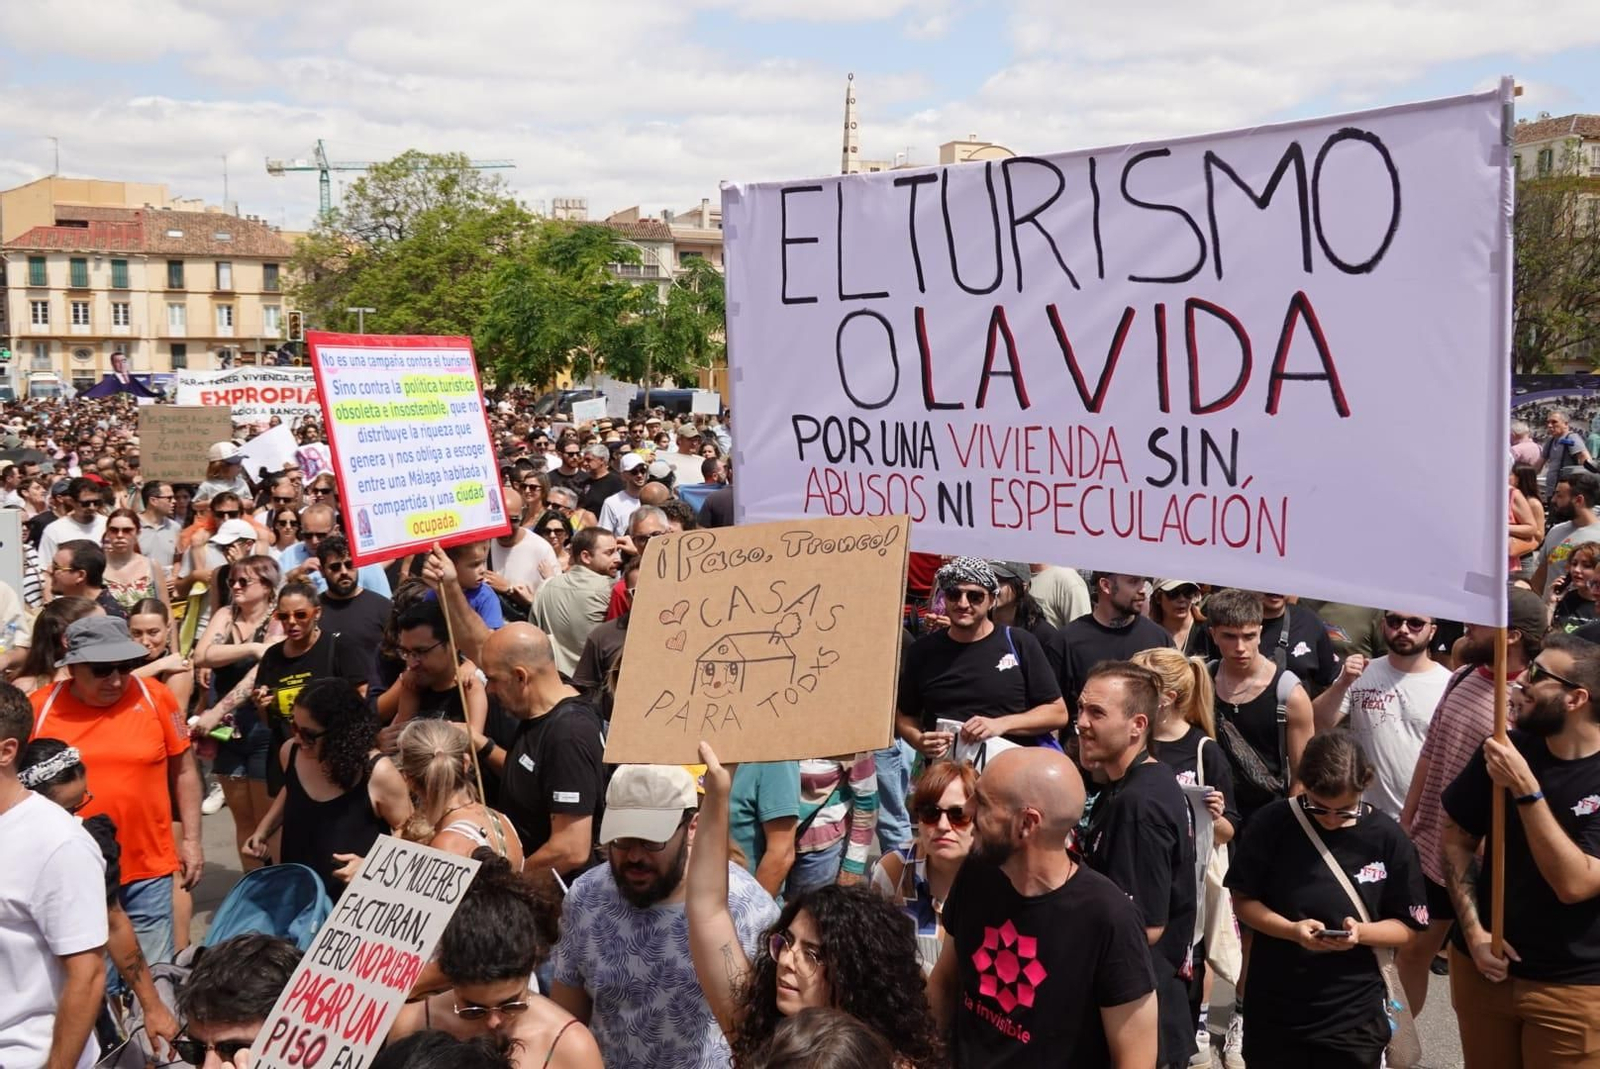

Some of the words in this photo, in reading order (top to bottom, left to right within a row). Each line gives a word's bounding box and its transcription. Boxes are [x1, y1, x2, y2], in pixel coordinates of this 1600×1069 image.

[780, 185, 889, 304] EL
[894, 127, 1401, 294] TURISMO
[321, 353, 335, 367] No
[337, 356, 348, 367] es
[349, 356, 366, 367] una
[367, 354, 405, 370] campaña
[406, 355, 432, 367] contra
[433, 354, 441, 367] el
[442, 355, 471, 368] turismo
[835, 308, 900, 410] O
[914, 304, 1031, 412] LA
[1045, 290, 1351, 418] VIDA
[242, 374, 290, 382] VIVIENDA
[332, 379, 357, 396] Sino
[359, 380, 390, 395] contra
[392, 380, 402, 394] la
[404, 378, 438, 396] política
[439, 377, 475, 393] turística
[335, 403, 381, 420] obsoleta
[382, 405, 389, 418] e
[390, 401, 449, 418] insostenible,
[450, 401, 467, 417] que
[468, 401, 479, 413] no
[357, 426, 408, 444] distribuye
[410, 425, 419, 440] la
[420, 424, 453, 441] riqueza
[454, 423, 472, 438] que
[791, 414, 874, 465] POR
[880, 420, 940, 472] UNA
[947, 423, 1128, 483] VIVIENDA
[1145, 426, 1239, 488] SIN
[350, 454, 386, 473] genera
[388, 454, 394, 469] y
[397, 451, 414, 465] nos
[415, 448, 444, 465] obliga
[445, 447, 452, 458] a
[453, 443, 486, 460] escoger
[358, 476, 386, 493] entre
[388, 475, 407, 488] una
[408, 468, 442, 487] Málaga
[443, 465, 481, 482] habitada
[482, 465, 489, 480] y
[372, 498, 428, 516] compartida
[430, 496, 436, 511] y
[437, 492, 455, 505] una
[456, 485, 485, 503] ciudad
[804, 466, 926, 523] ABUSOS
[937, 479, 974, 528] NI
[990, 476, 1288, 558] ESPECULACIÓN
[412, 513, 458, 535] ocupada.
[781, 524, 900, 558] Tronco!
[699, 580, 845, 632] CASAS
[644, 689, 742, 733] PARA
[1362, 700, 1386, 711] REAL
[362, 845, 407, 887] LAS
[394, 852, 471, 905] MUJERES
[334, 892, 431, 951] FACTURAN,
[311, 927, 360, 971] PERO
[348, 941, 384, 980] NO
[282, 968, 354, 1032] PAGAR
[342, 994, 389, 1046] UN
[976, 1000, 1032, 1044] invisible
[262, 1017, 328, 1069] PISO
